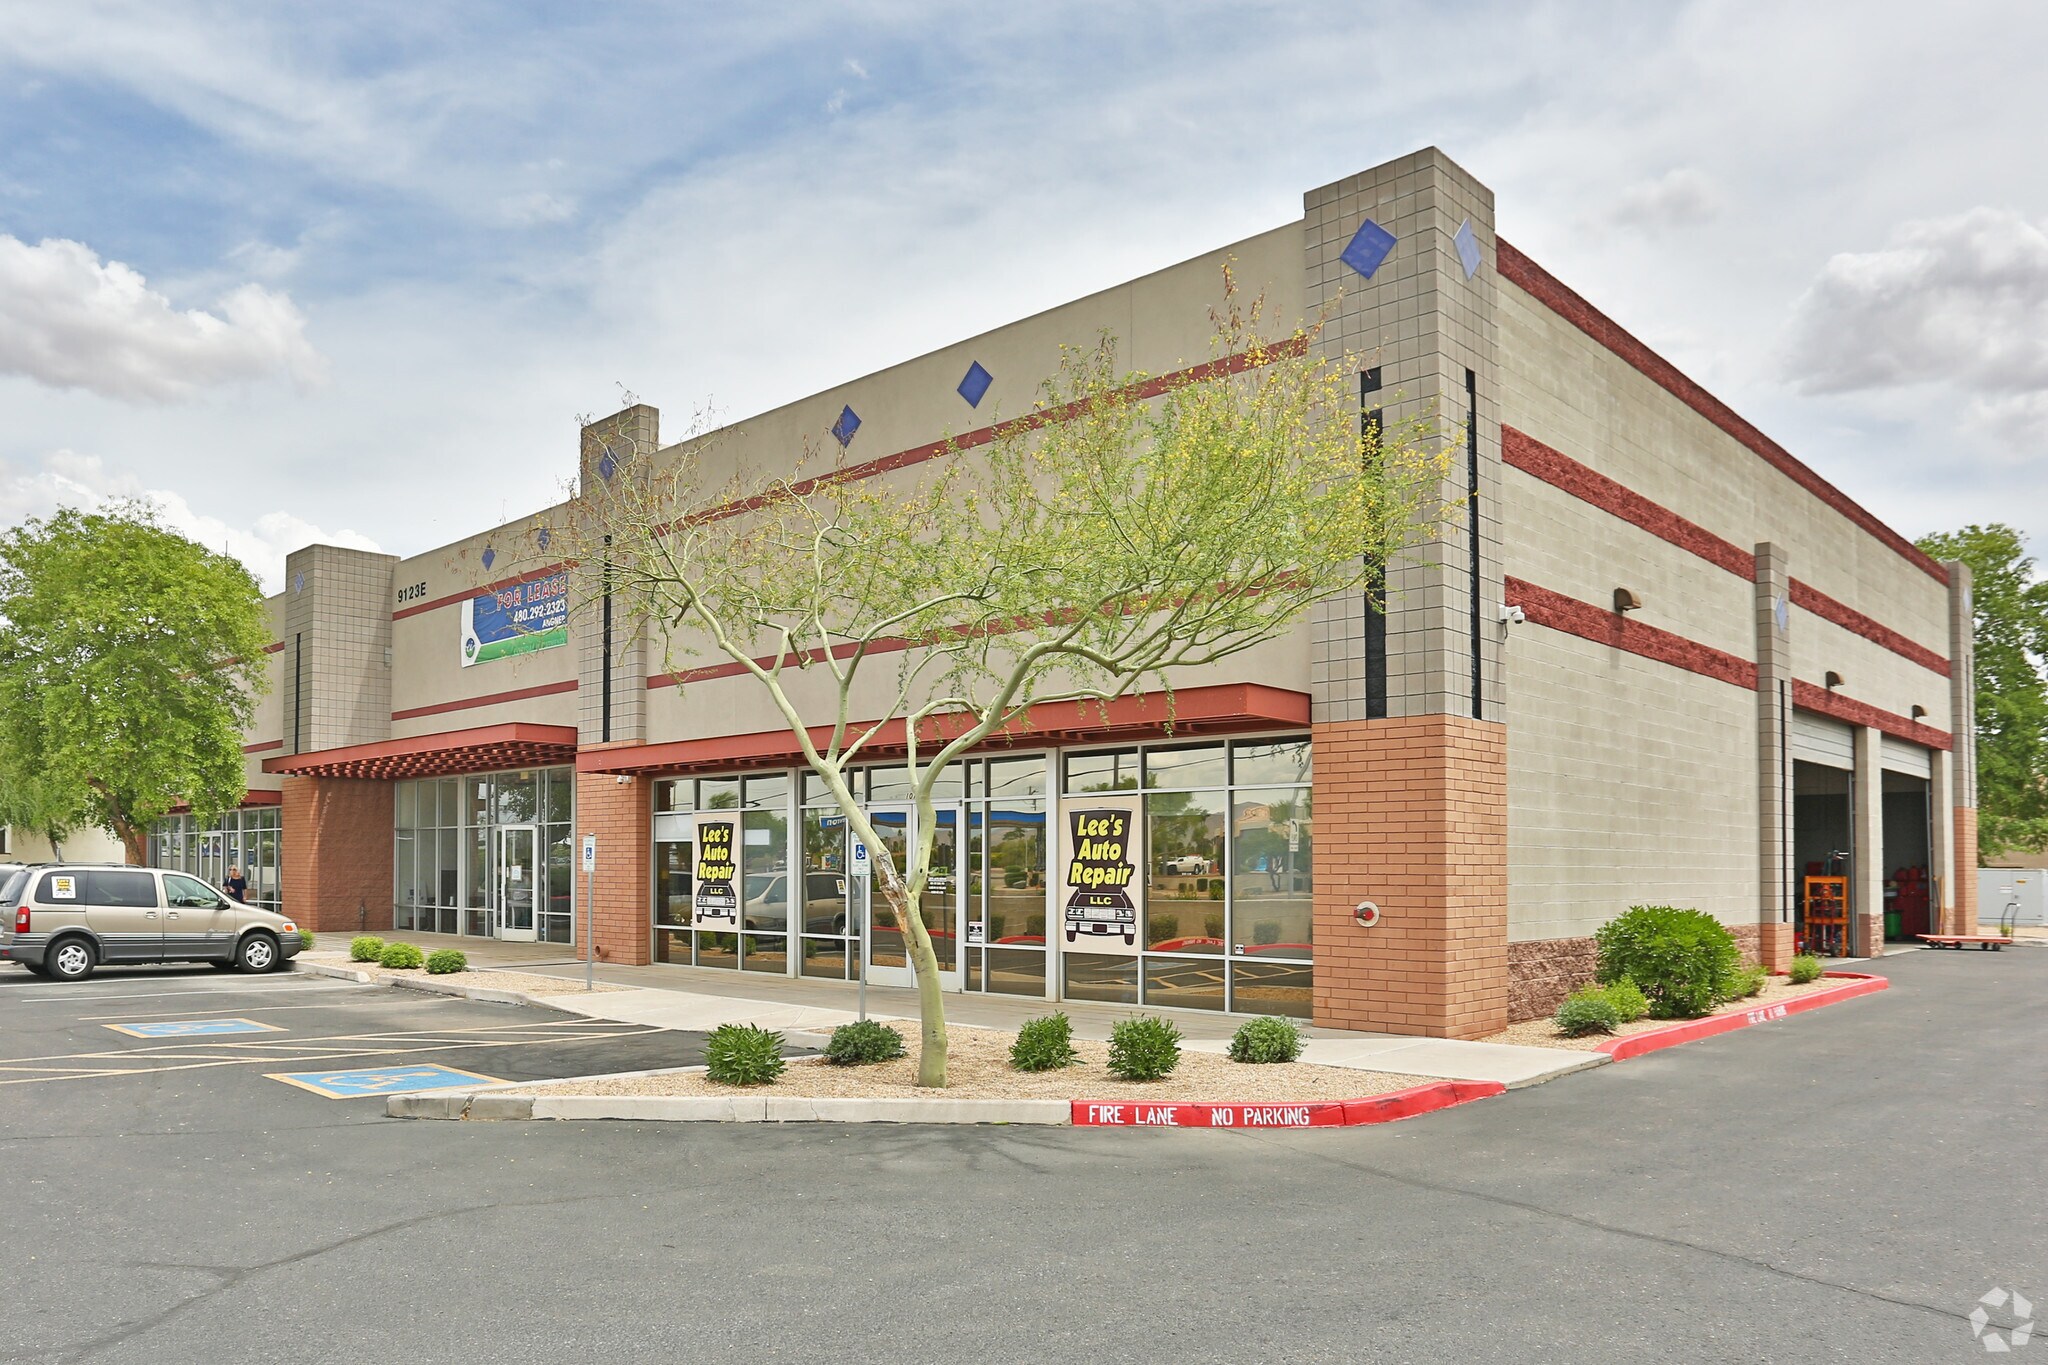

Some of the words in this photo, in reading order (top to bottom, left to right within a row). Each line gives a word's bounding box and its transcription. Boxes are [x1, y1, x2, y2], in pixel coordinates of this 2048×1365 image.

[397, 581, 426, 603] 9123E
[496, 588, 521, 611] FOR
[527, 575, 566, 603] LEASE
[702, 825, 729, 842] Lee's
[1077, 814, 1123, 836] Lee's
[703, 844, 728, 860] Auto
[1077, 838, 1121, 860] Auto
[698, 861, 734, 882] Repair
[1070, 861, 1131, 889] Repair
[1089, 896, 1112, 905] LLC
[1088, 1105, 1124, 1123] FIRE
[1135, 1107, 1178, 1126] LANE
[1211, 1108, 1233, 1126] NO
[1243, 1107, 1310, 1126] PARKING
